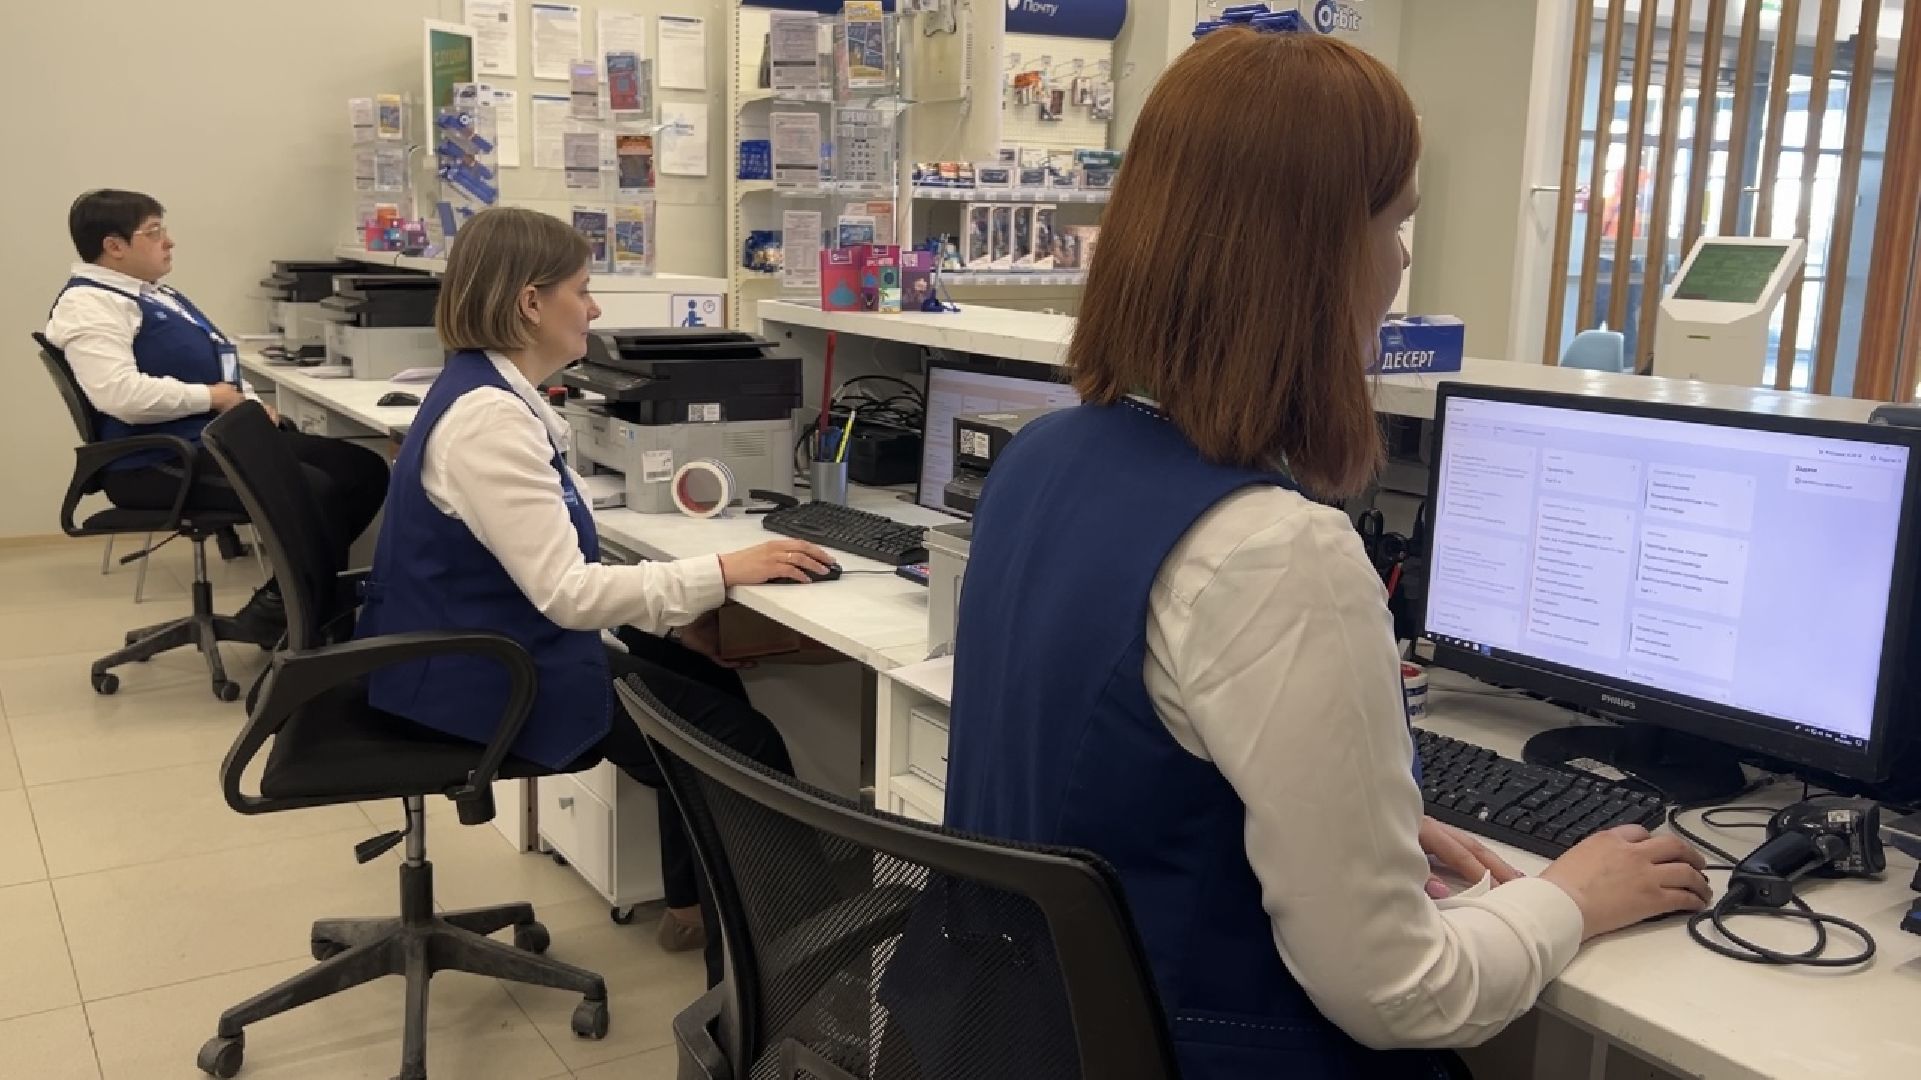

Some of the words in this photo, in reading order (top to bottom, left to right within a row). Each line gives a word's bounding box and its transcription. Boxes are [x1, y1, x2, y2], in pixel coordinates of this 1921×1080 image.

[1316, 2, 1361, 31] Orbit
[1382, 350, 1435, 370] ДЕСЕРТ
[1601, 693, 1636, 710] PHILIPS
